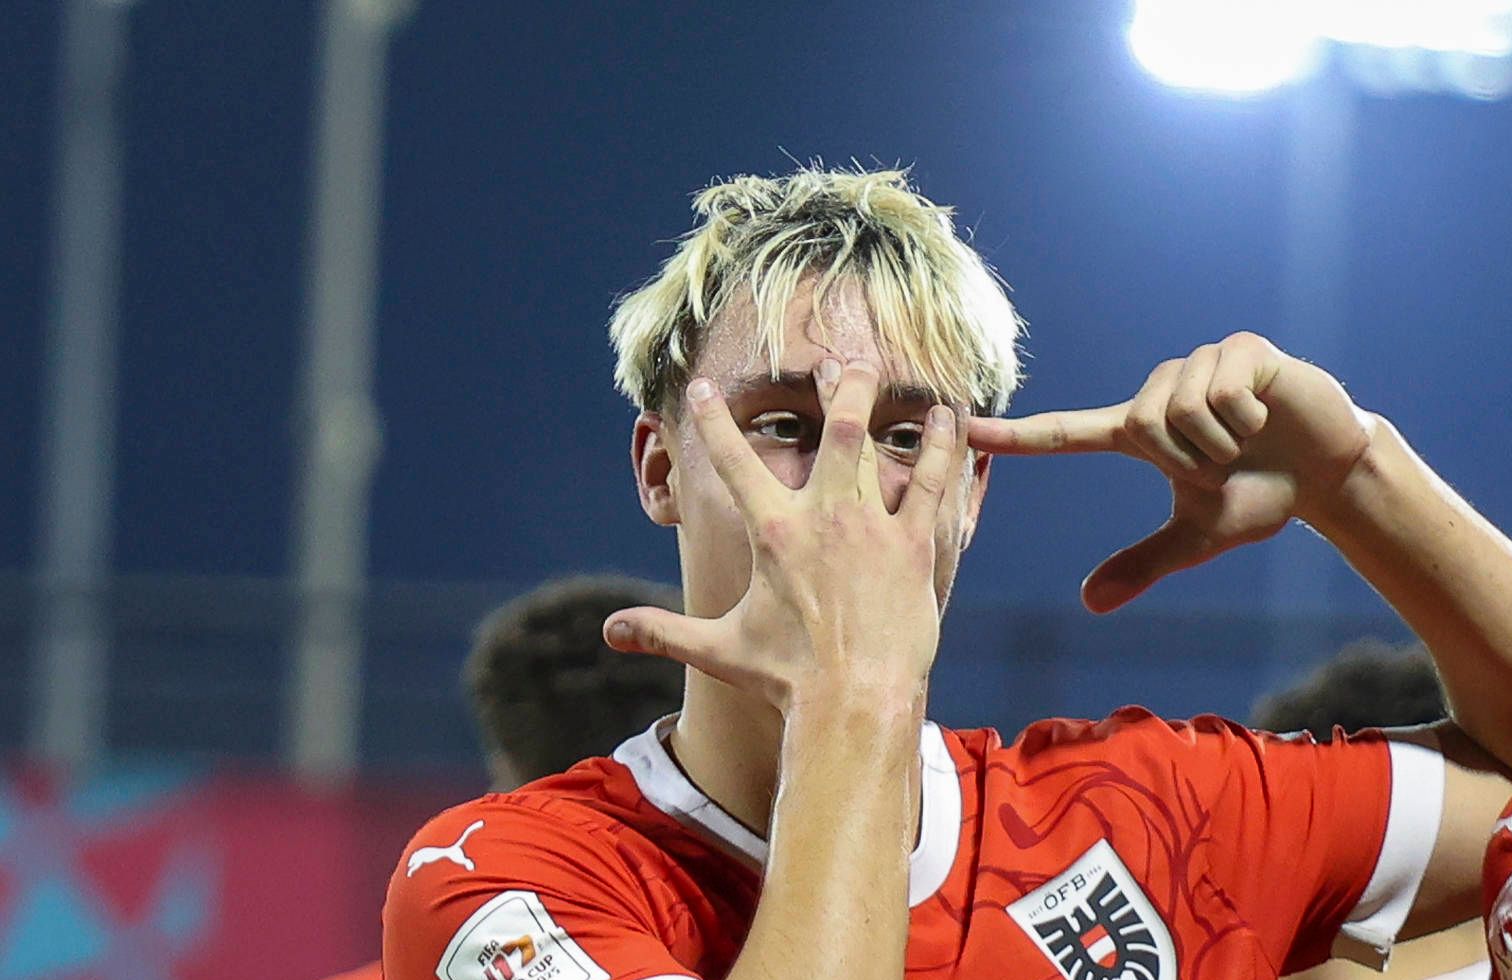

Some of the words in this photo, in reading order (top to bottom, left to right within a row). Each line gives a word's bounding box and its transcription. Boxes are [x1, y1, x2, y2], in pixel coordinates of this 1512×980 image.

[1043, 873, 1087, 909] ÖFB
[477, 939, 500, 967] FIFA
[527, 954, 553, 978] CUP
